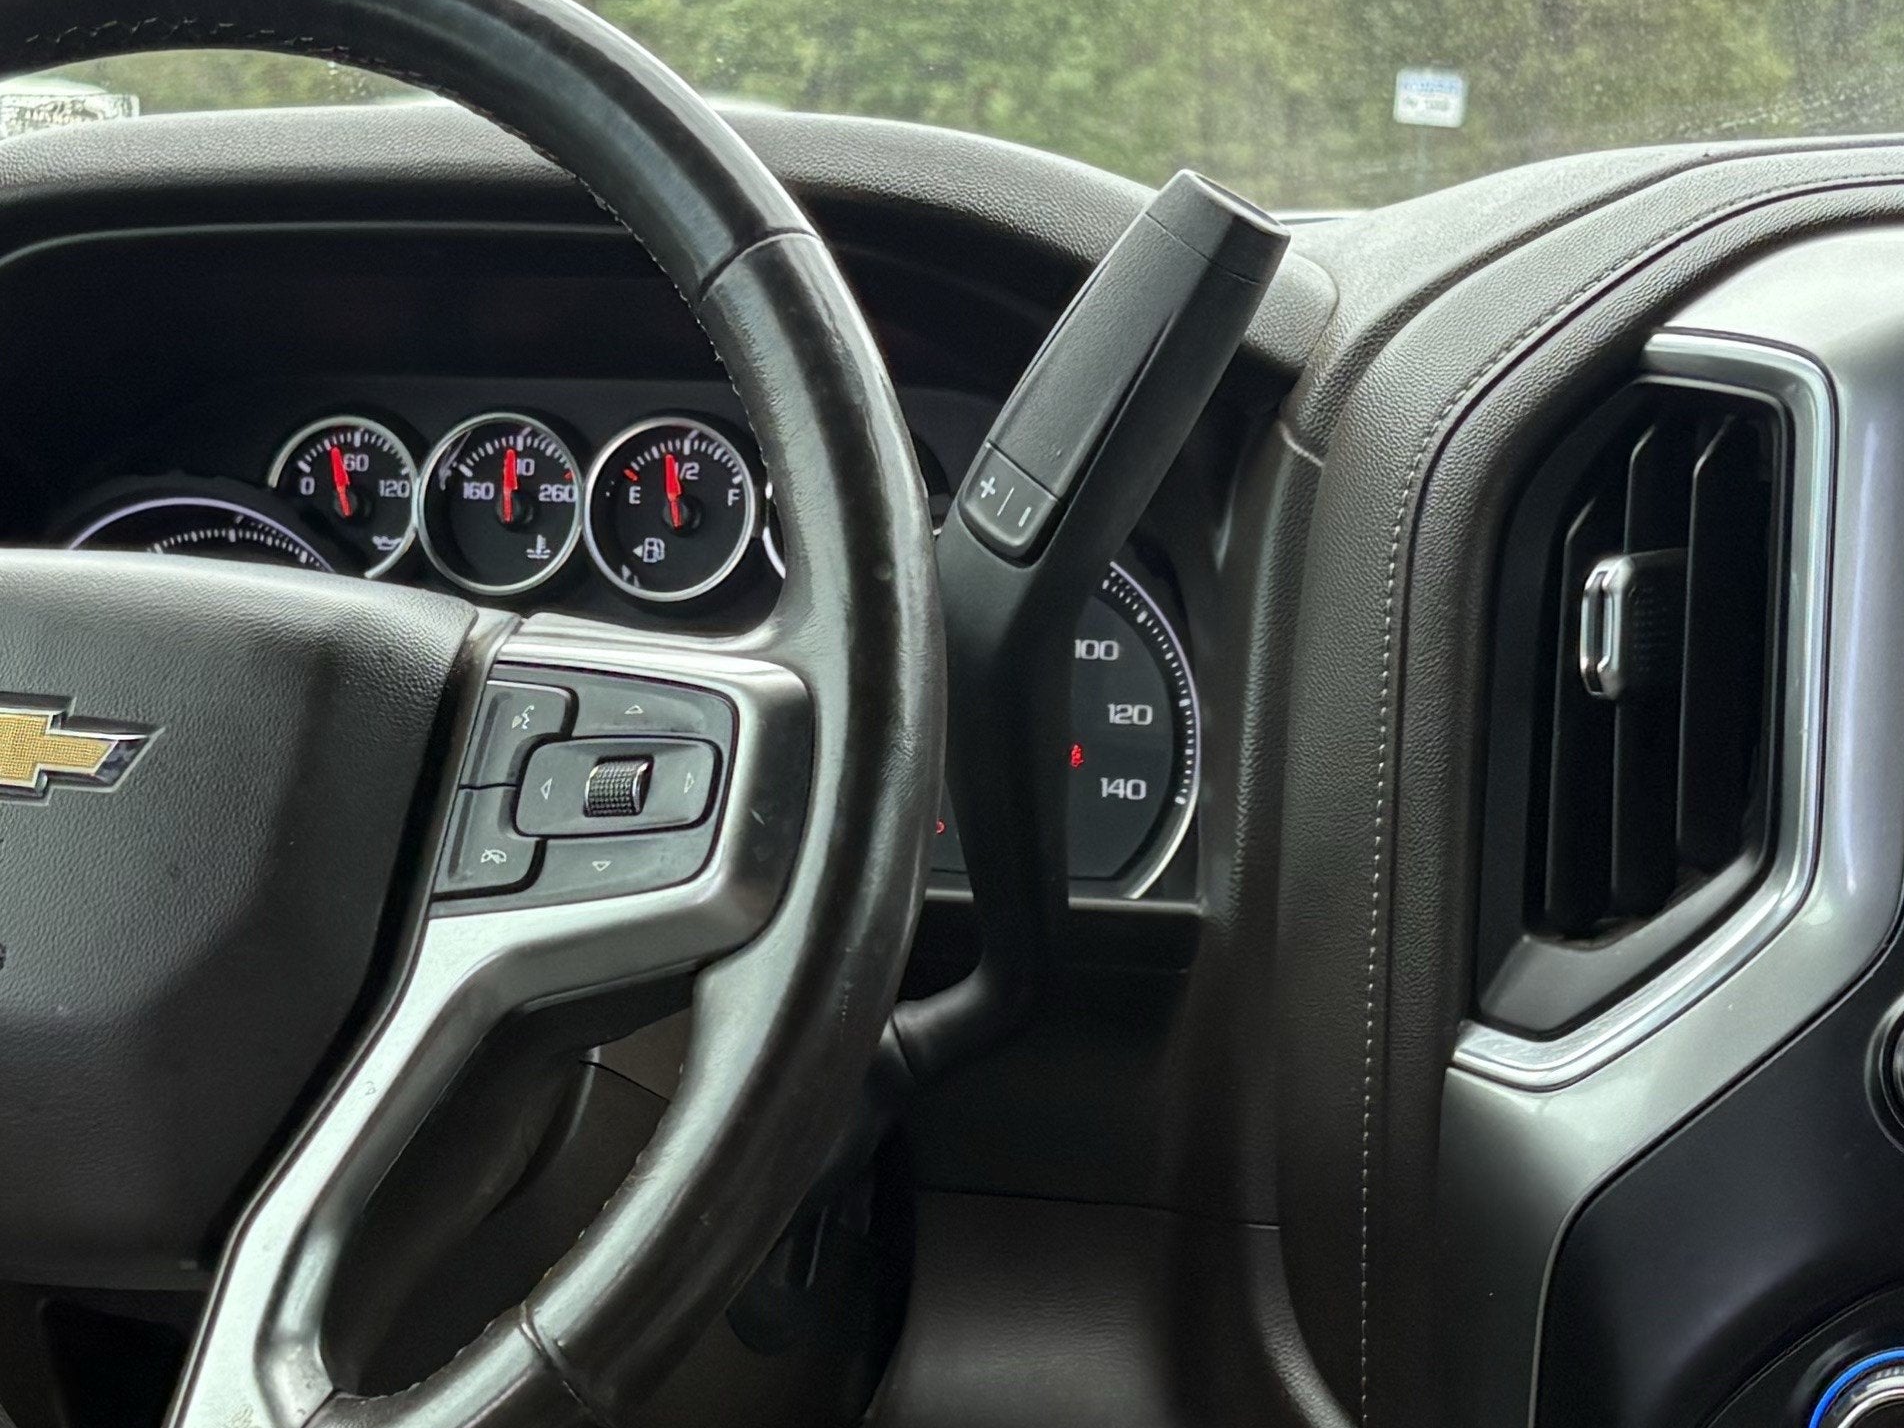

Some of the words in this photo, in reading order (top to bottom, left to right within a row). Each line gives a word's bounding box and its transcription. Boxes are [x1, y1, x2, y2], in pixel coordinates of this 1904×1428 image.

[299, 479, 315, 496] 0
[378, 479, 410, 498] 120
[462, 482, 494, 501] 160
[538, 483, 577, 503] 260
[628, 486, 642, 504] E
[727, 488, 740, 506] F
[1074, 638, 1120, 661] 100
[1107, 702, 1153, 726] 120
[1100, 777, 1146, 800] 140
